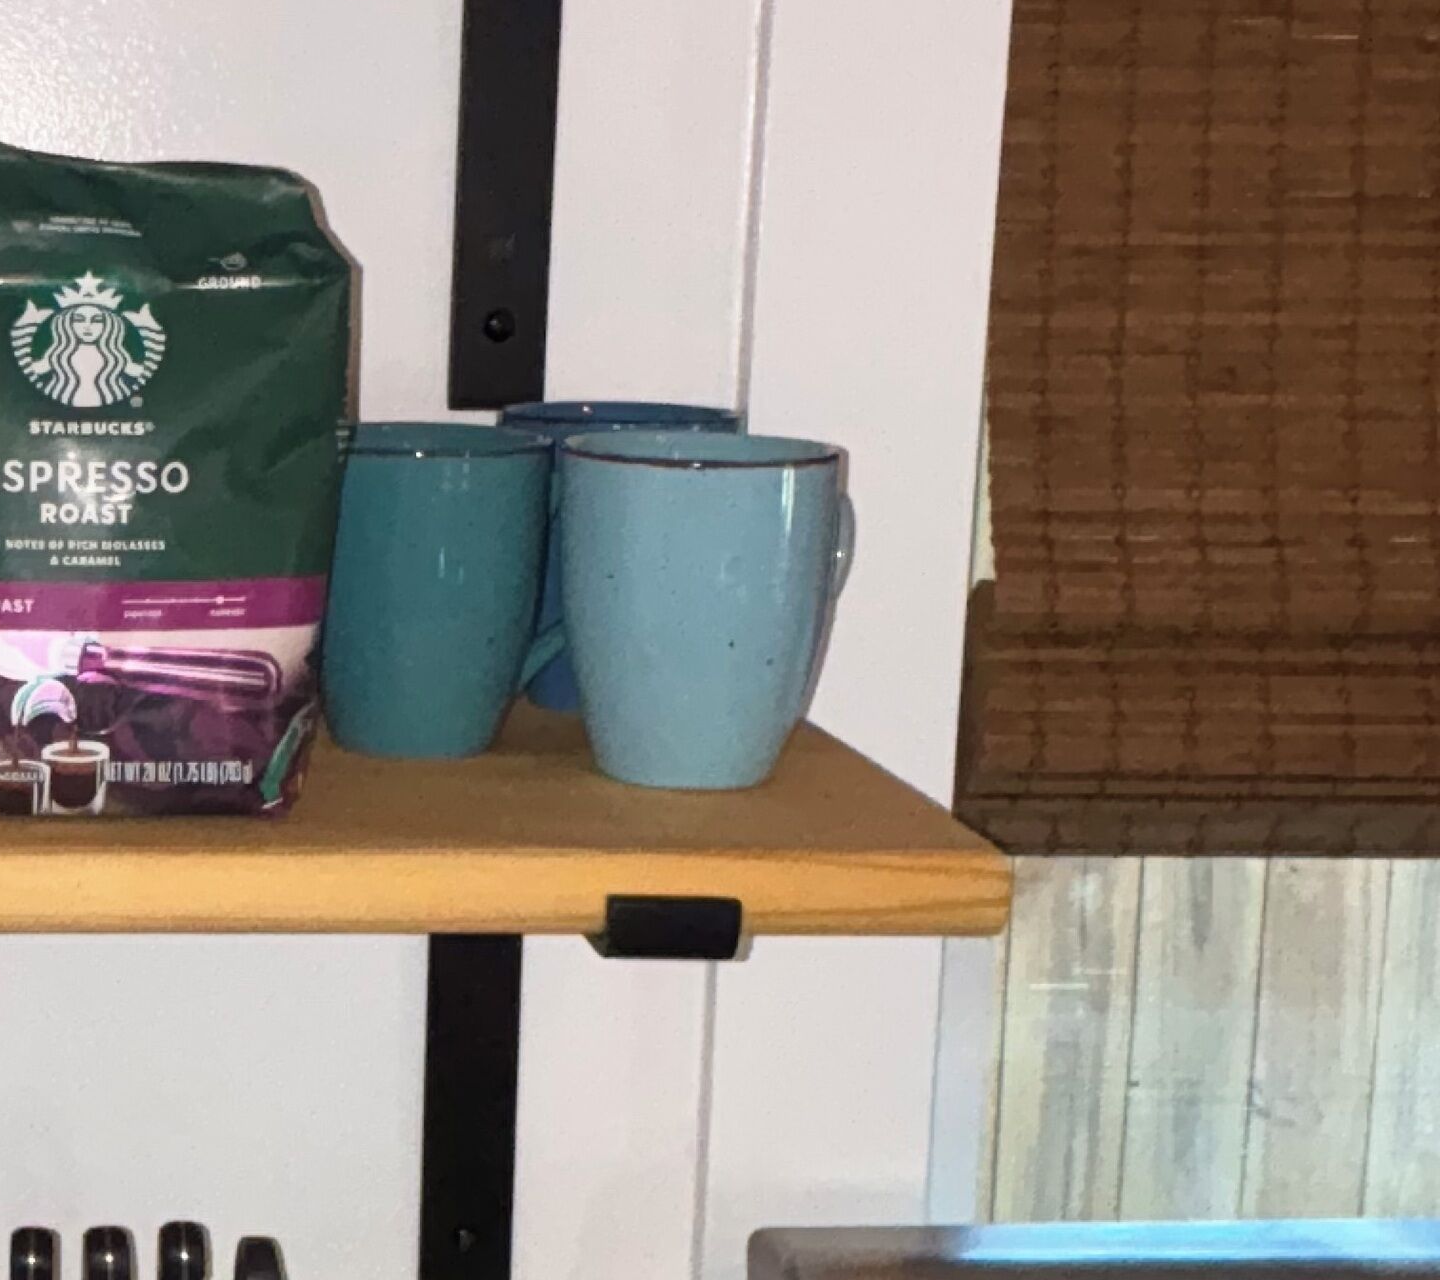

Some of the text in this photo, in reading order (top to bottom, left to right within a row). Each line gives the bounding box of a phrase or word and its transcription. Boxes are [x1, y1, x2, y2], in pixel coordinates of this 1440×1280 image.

[198, 275, 261, 289] GROUND
[29, 421, 145, 436] STARBUCKS
[40, 503, 132, 525] ROAST
[5, 540, 165, 551] NOTES OF RICH MOLASSES
[62, 556, 121, 567] CARAMEL
